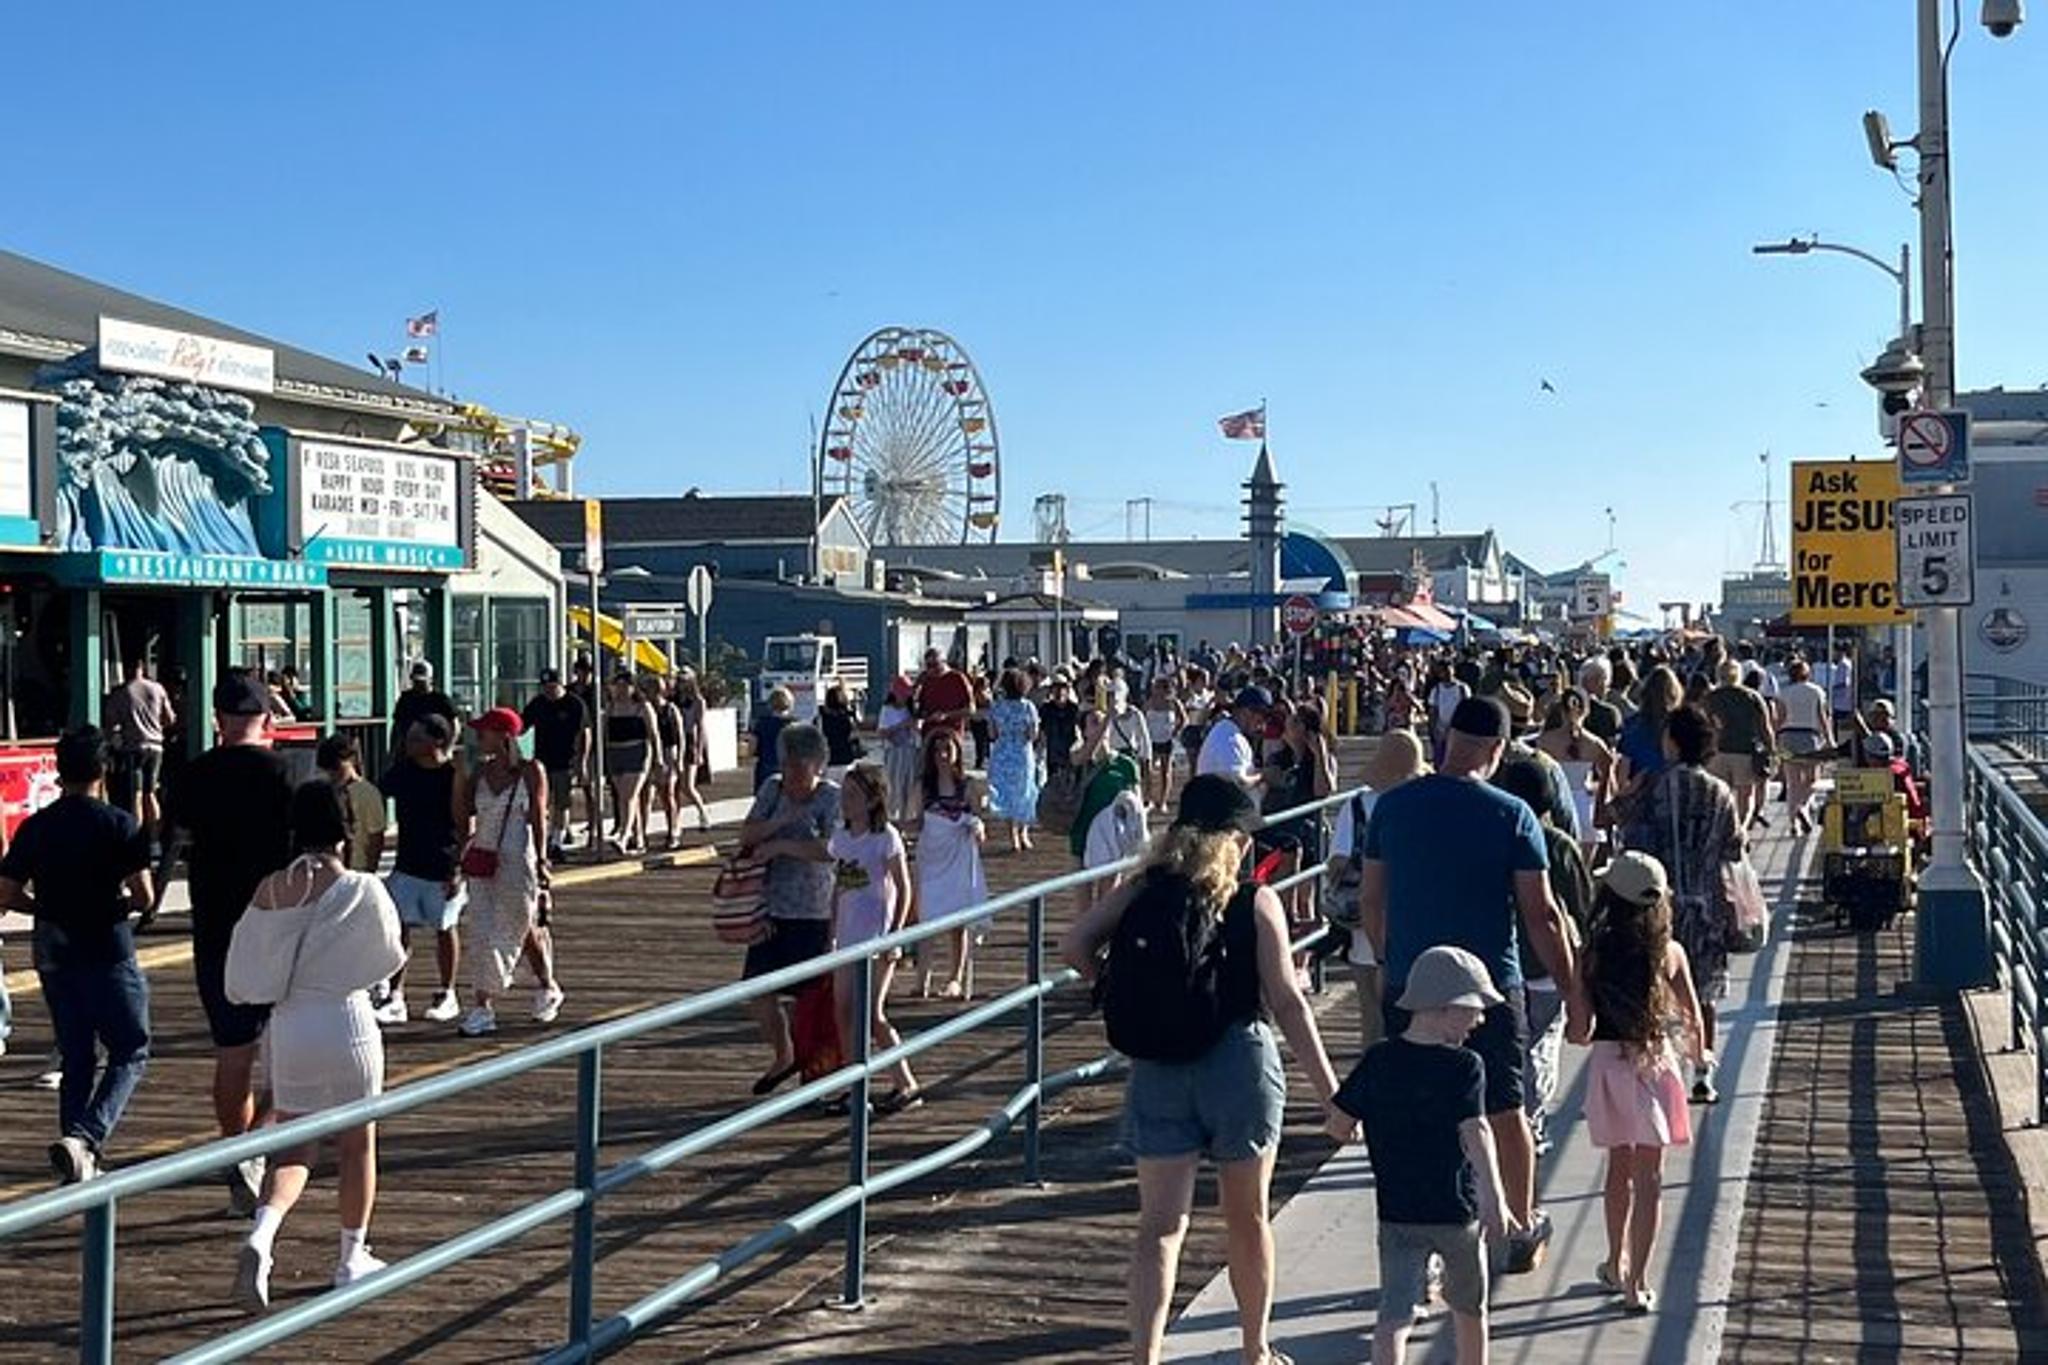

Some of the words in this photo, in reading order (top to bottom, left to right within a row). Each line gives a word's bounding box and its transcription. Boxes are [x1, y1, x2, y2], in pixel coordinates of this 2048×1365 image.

[321, 472, 351, 492] HAPPY
[361, 477, 385, 495] HOUR
[394, 480, 420, 497] EVERY
[426, 483, 442, 500] DAY
[1809, 471, 1858, 493] Ask
[1902, 506, 1967, 526] SPEED
[1908, 531, 1959, 549] LIMIT
[338, 544, 374, 560] LIVE
[386, 546, 434, 565] MUSIC
[1798, 550, 1832, 571] for
[129, 556, 252, 580] RESTAURANT
[272, 564, 305, 581] BAR
[1922, 557, 1949, 596] 5
[1587, 596, 1599, 612] 5
